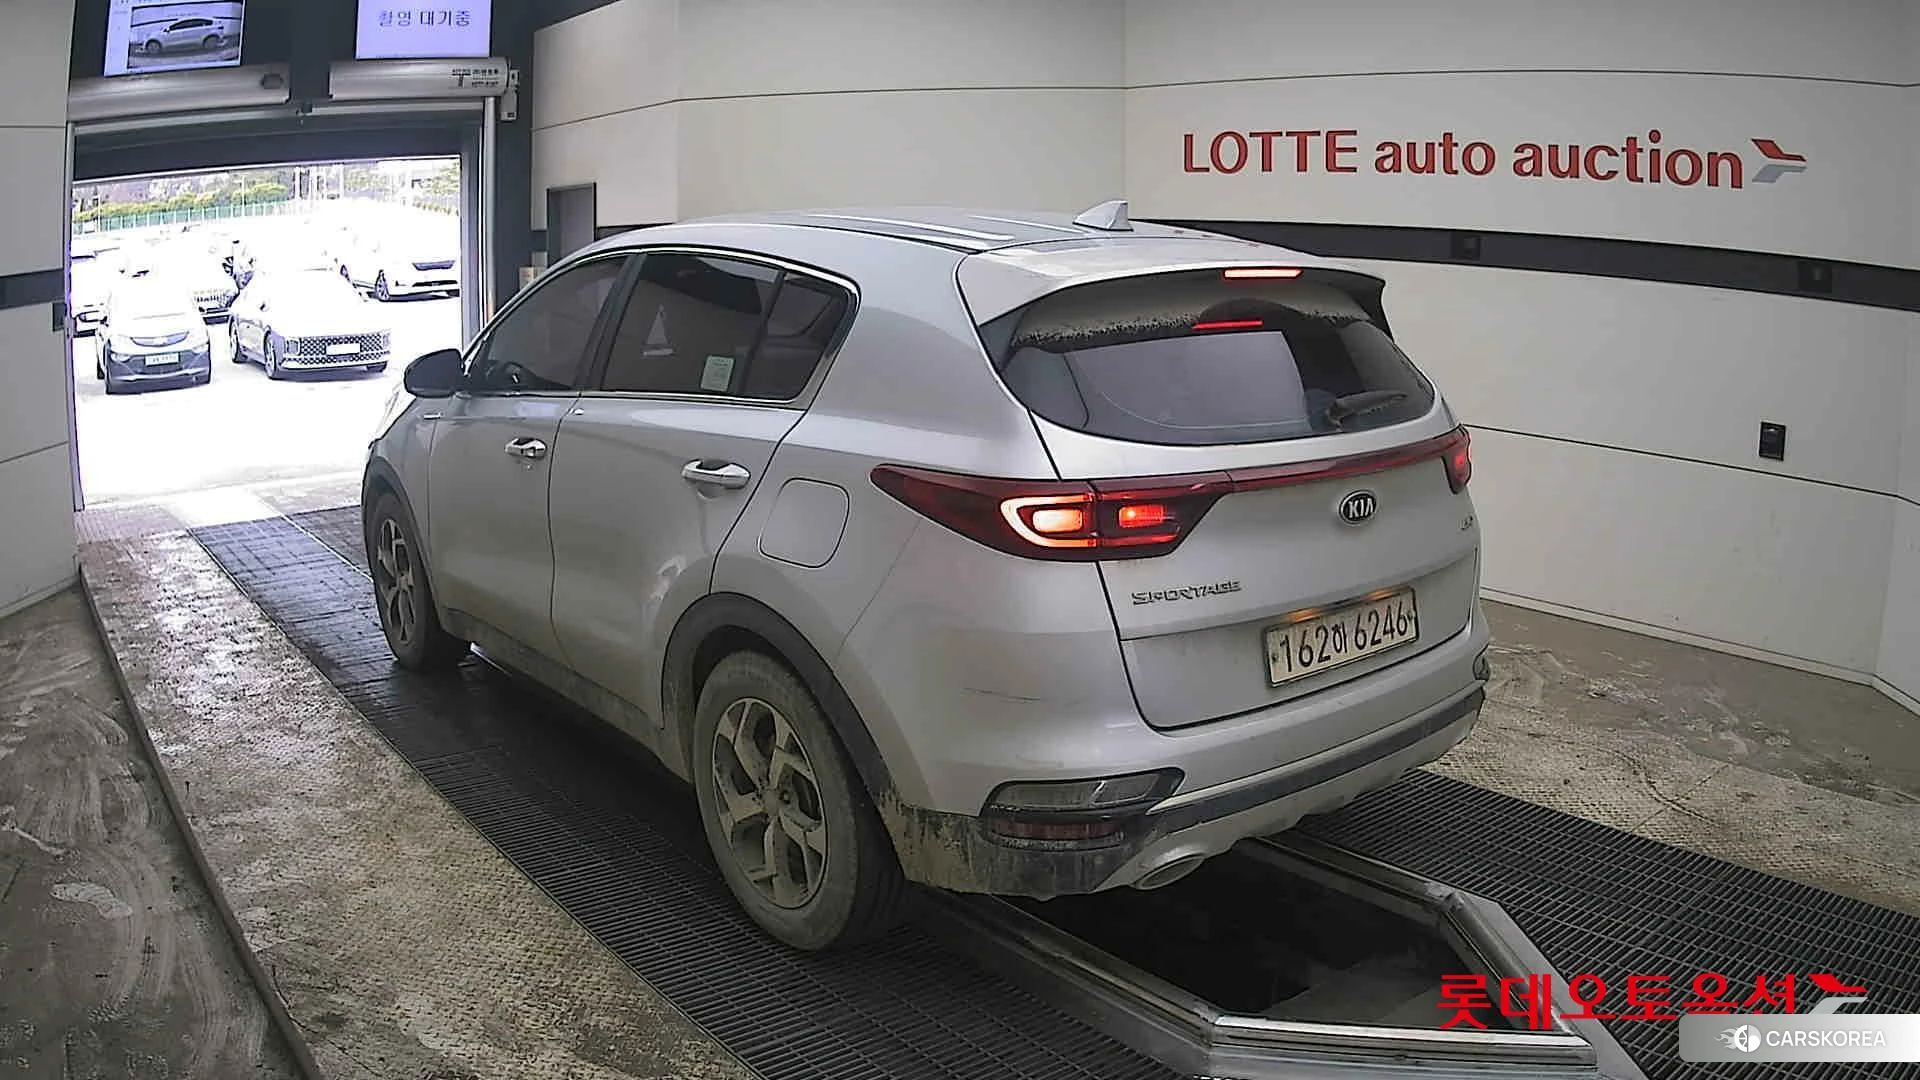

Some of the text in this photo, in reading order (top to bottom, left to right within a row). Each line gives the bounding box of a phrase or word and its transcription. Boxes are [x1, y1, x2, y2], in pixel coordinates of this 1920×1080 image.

[420, 10, 471, 27] 대기중
[1183, 129, 1743, 189] LOTTE auto auction
[1348, 498, 1374, 519] KIA
[1131, 580, 1242, 605] SPORTAGE
[1280, 601, 1408, 673] 162하 6246
